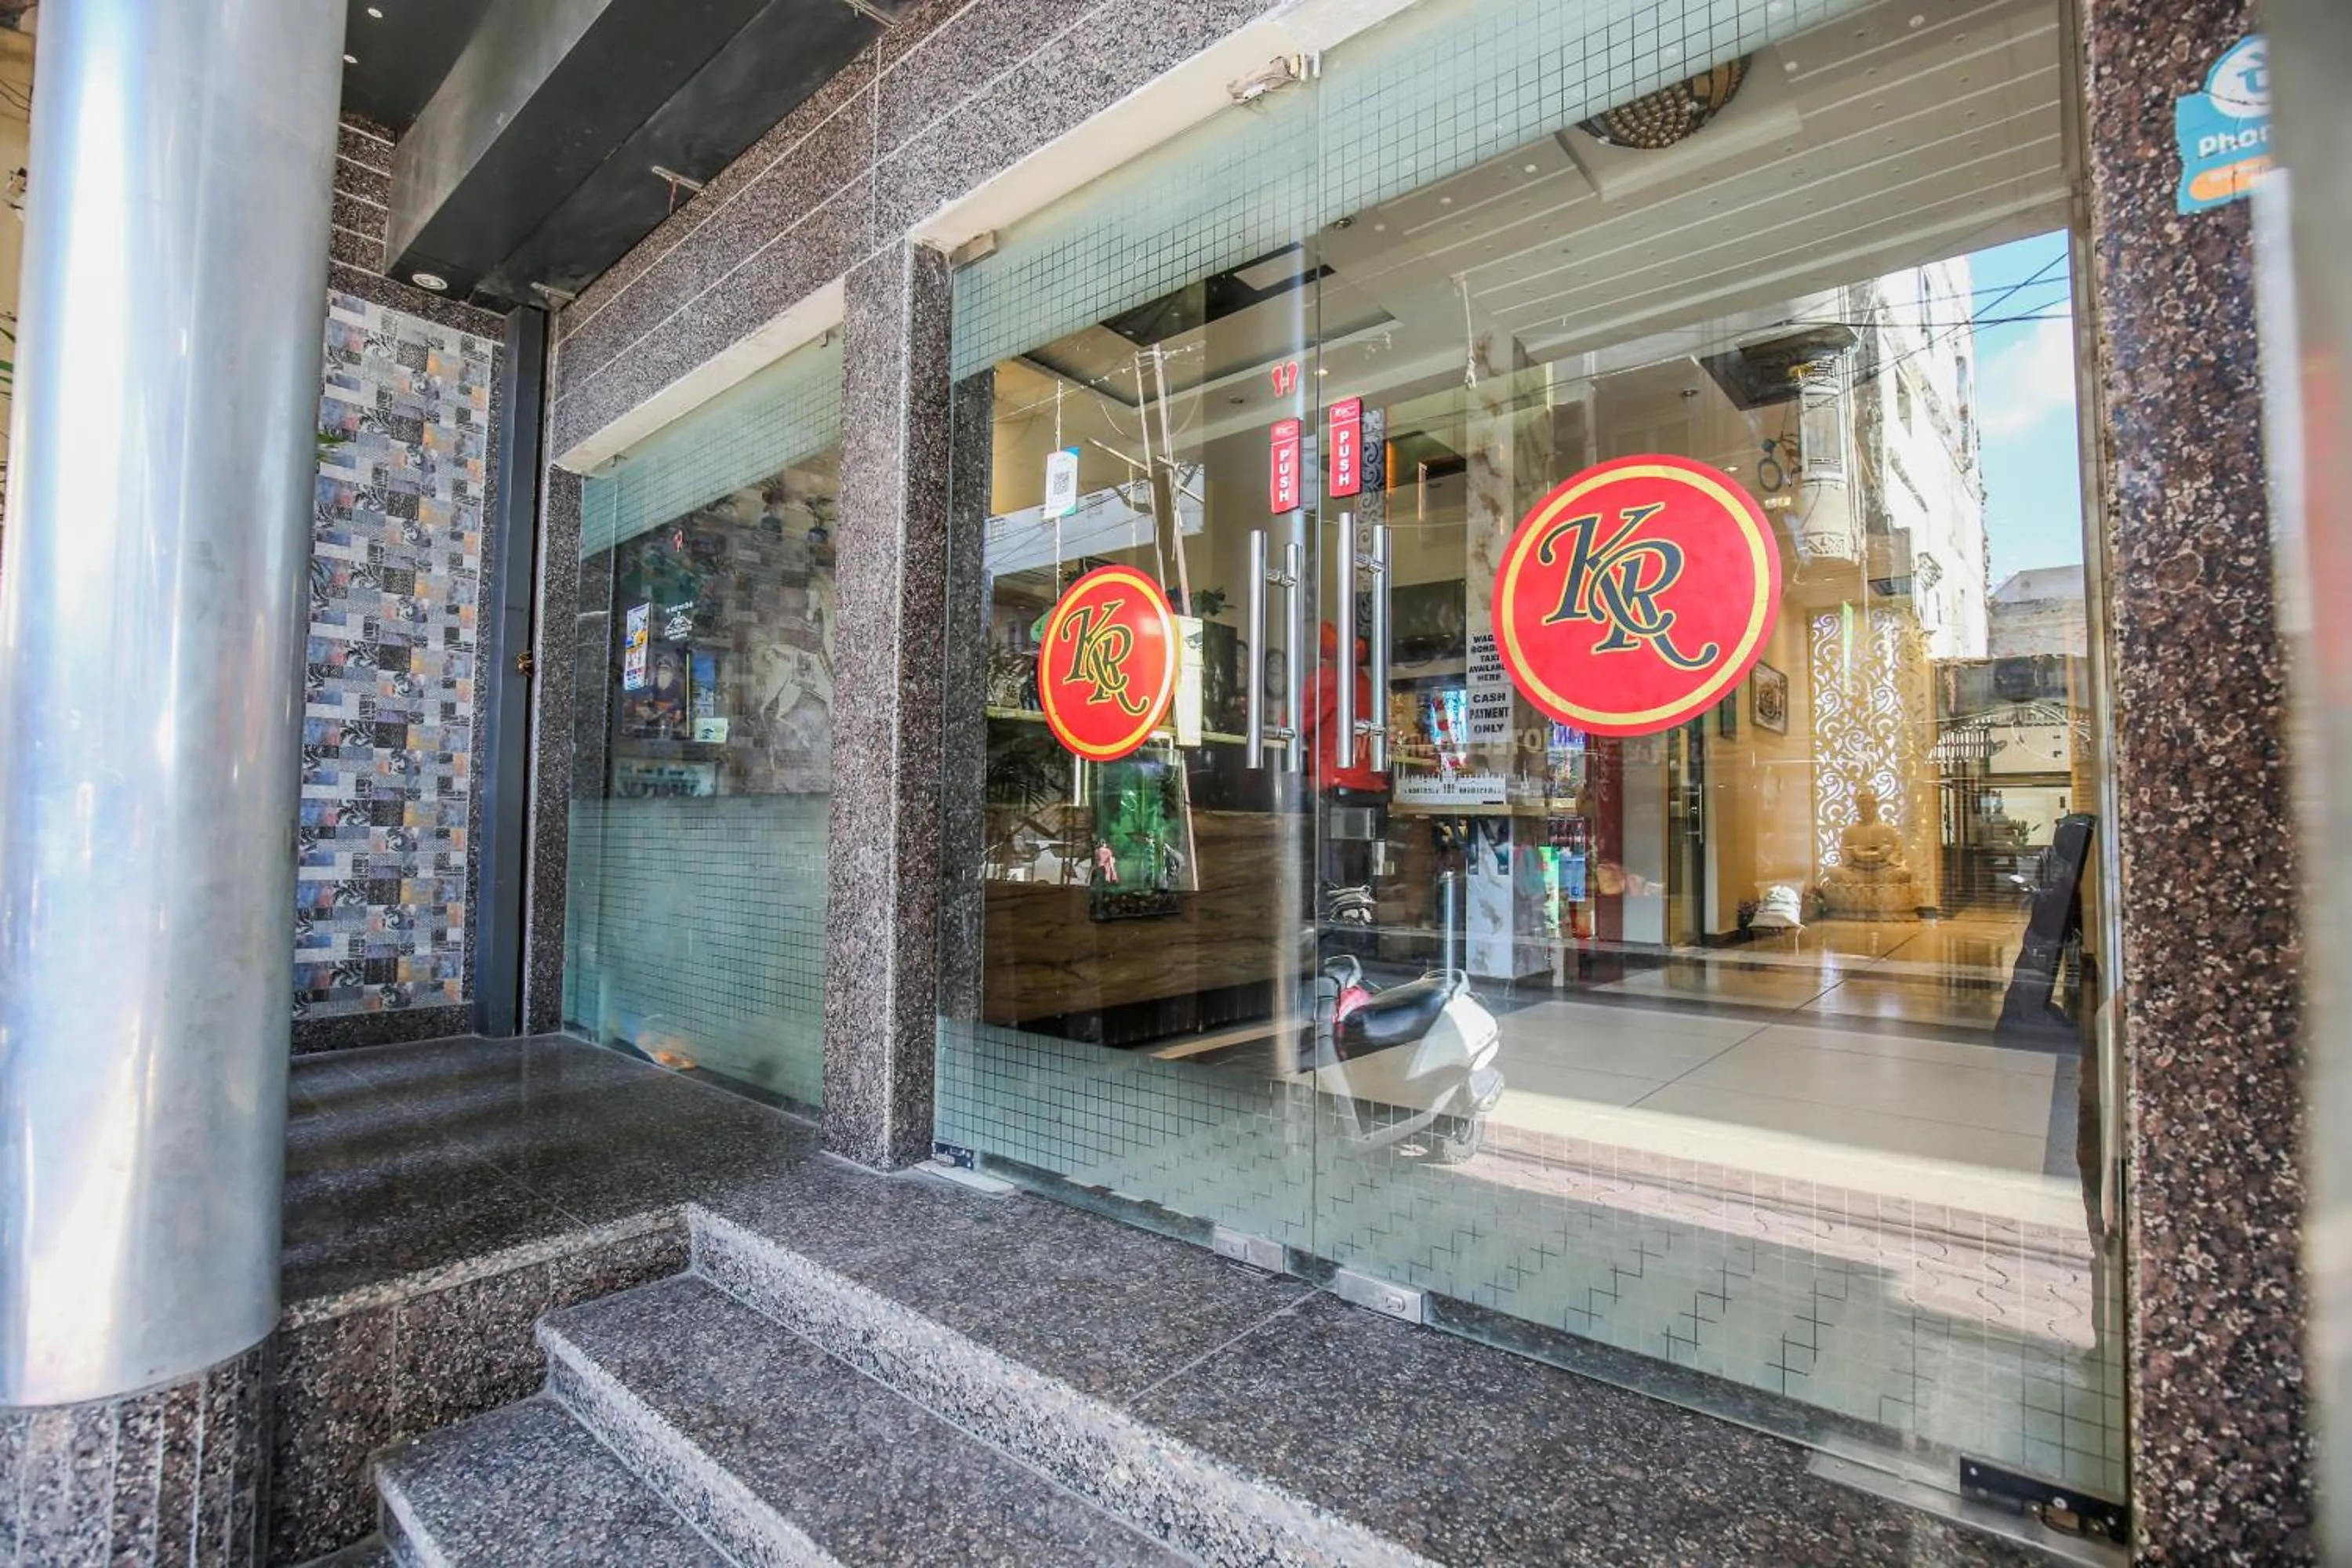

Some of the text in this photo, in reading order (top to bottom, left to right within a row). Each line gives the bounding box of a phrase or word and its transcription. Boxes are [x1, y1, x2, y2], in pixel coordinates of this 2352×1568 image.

[1339, 430, 1349, 486] PUSH
[1279, 449, 1290, 502] PUSH
[1468, 663, 1506, 673] AVAILABL
[1473, 692, 1506, 703] CASH
[1469, 706, 1509, 720] PAYMENT
[1474, 723, 1504, 734] ONLY
